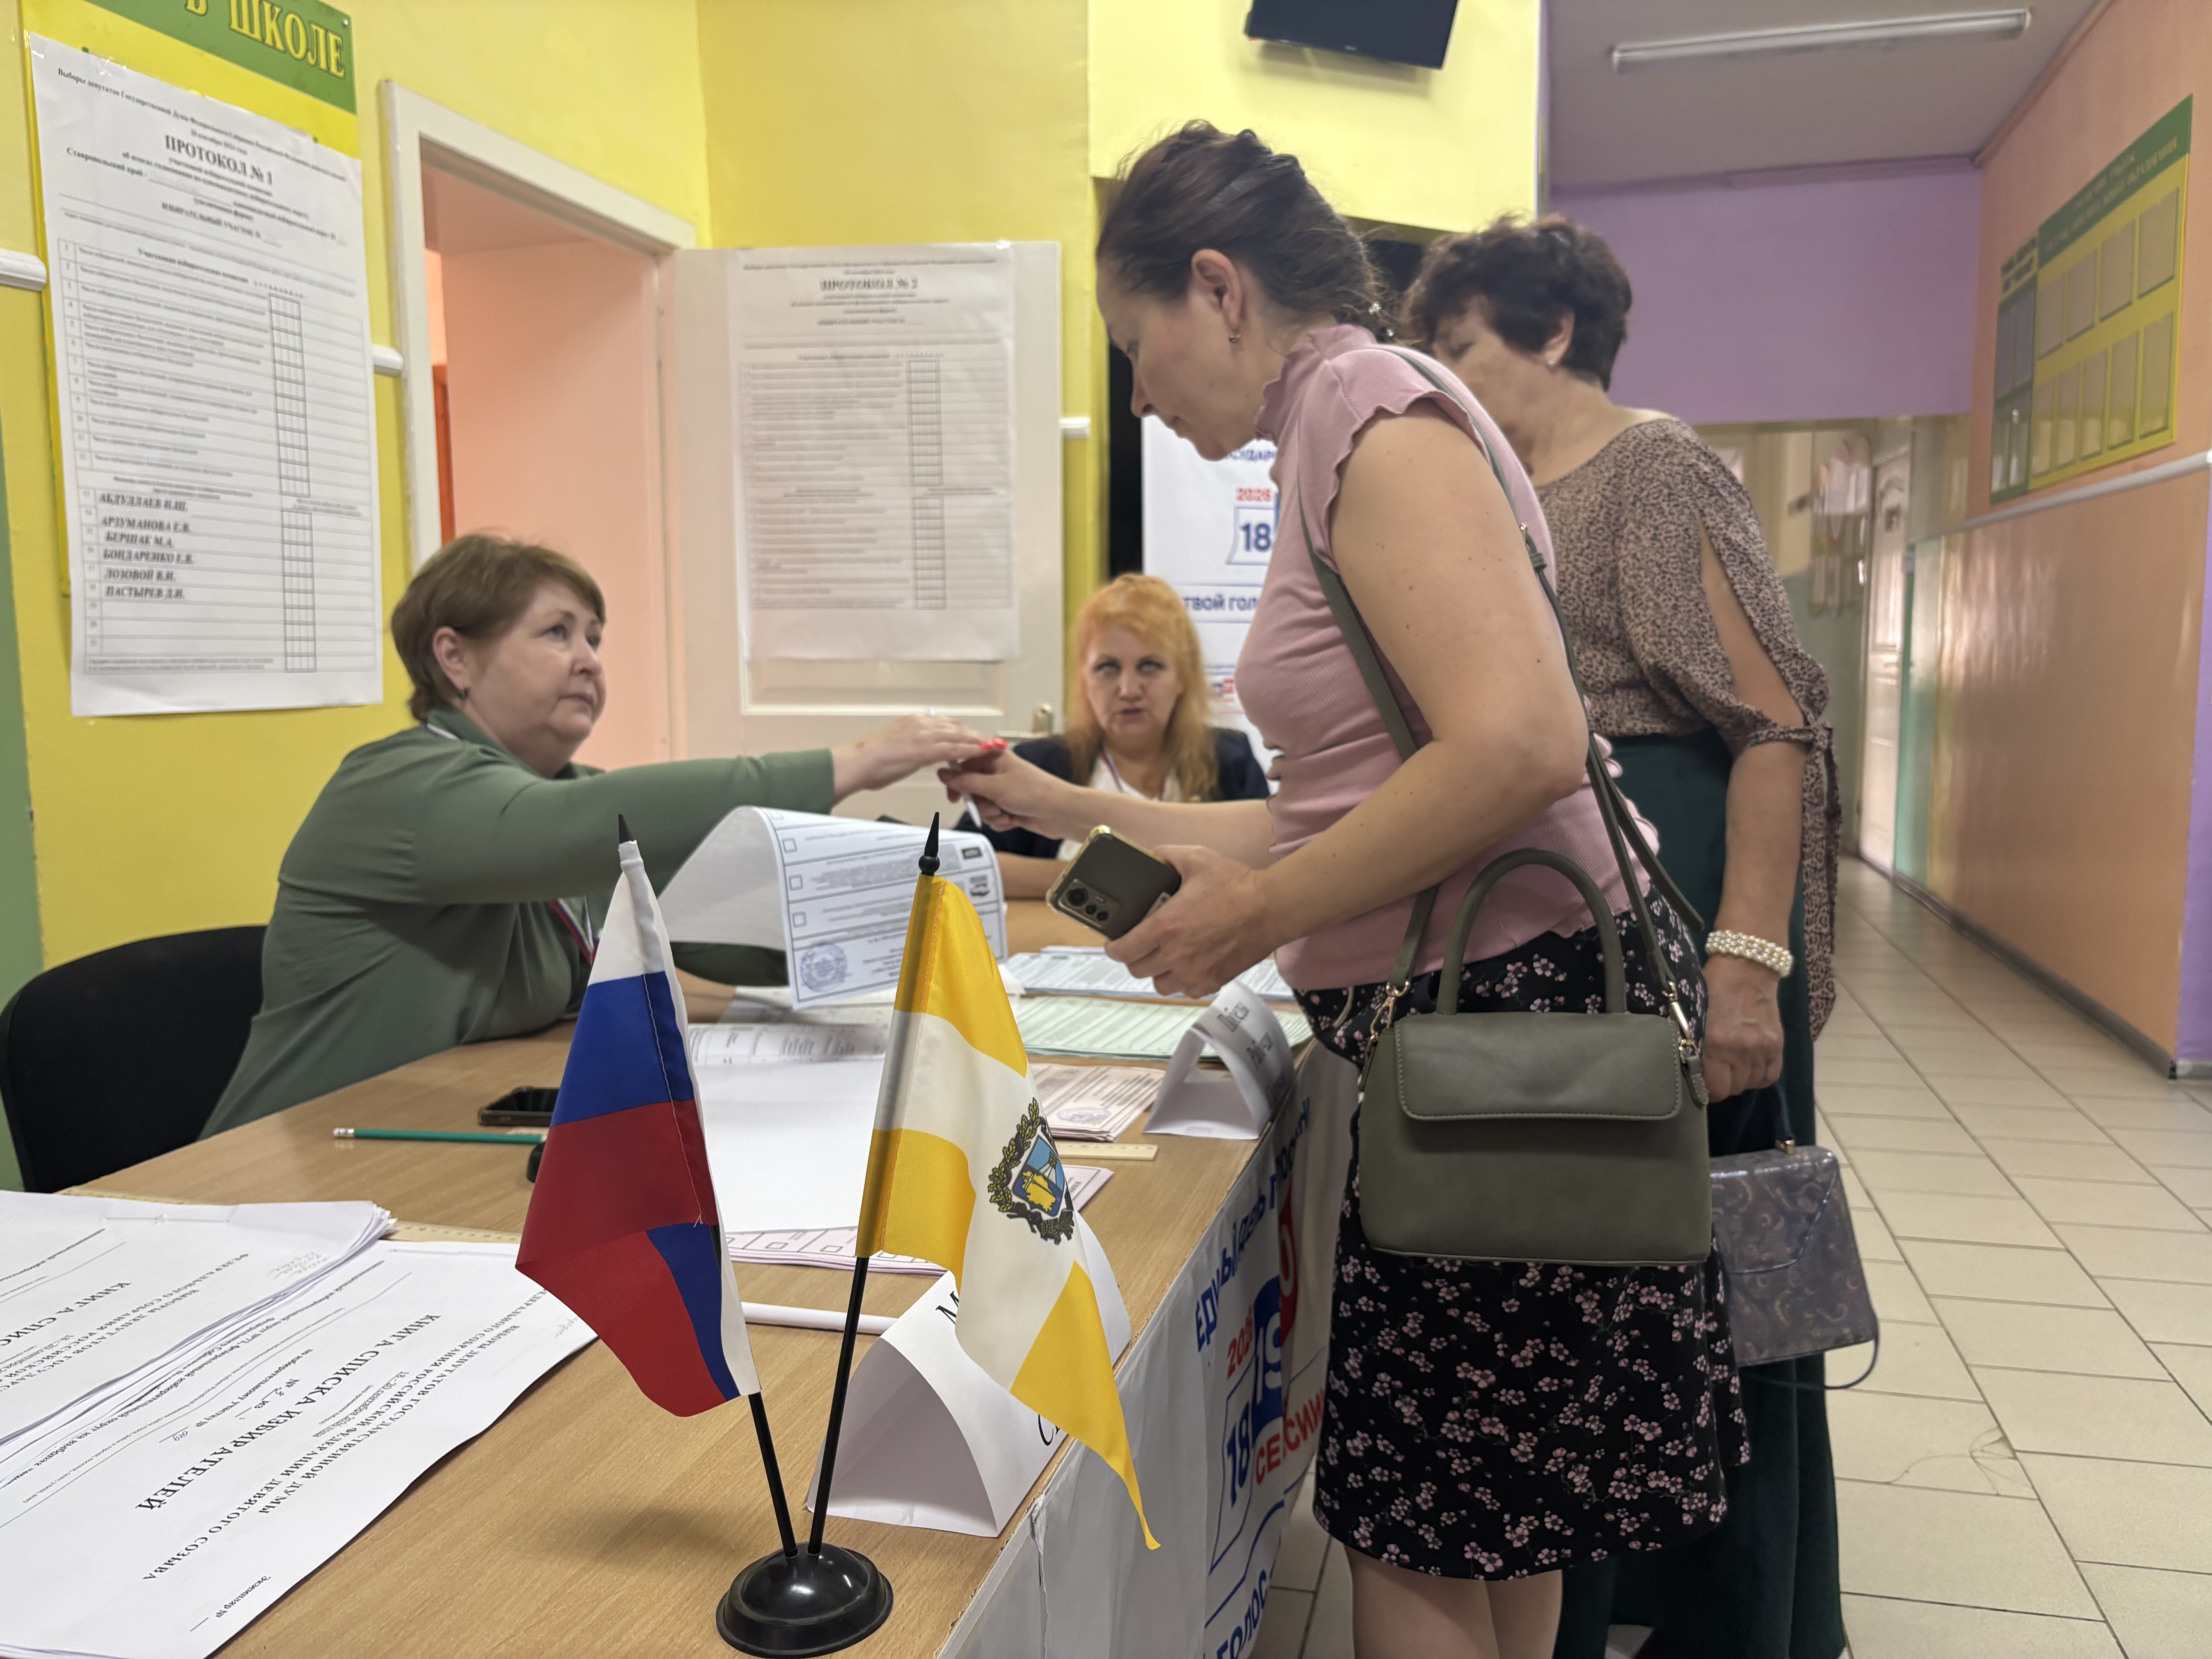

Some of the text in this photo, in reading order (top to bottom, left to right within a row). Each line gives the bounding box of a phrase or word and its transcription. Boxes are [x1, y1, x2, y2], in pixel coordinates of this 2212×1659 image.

[228, 0, 345, 80] ШКОЛЕ
[165, 134, 247, 177] ПРОТОКОЛ
[1240, 522, 1271, 552] 18
[55, 1283, 132, 1314] КНИГА
[483, 1289, 546, 1332] ЕДЕРАЛЬНОГО
[374, 1315, 441, 1348] КНИГА
[285, 1379, 301, 1388] №
[295, 1351, 379, 1406] СПИСКА
[417, 1350, 479, 1395] ДЕПУТАТОВ
[254, 1399, 270, 1408] из
[355, 1369, 434, 1426] РОССИЙСКОЙ
[135, 1410, 303, 1510] ИЗБИРАТЕЛЕЙ
[279, 1428, 357, 1476] ФЕДЕРАЦИИ
[300, 1399, 421, 1479] ГОСУДАРСТВЕННОЙ
[1227, 1399, 1250, 1509] 18
[209, 1479, 283, 1533] ДЕВЯТОГО
[257, 1481, 303, 1514] ДУМЫ
[142, 1537, 208, 1580] СОЗЫВА
[223, 1576, 271, 1609] Экземпляр
